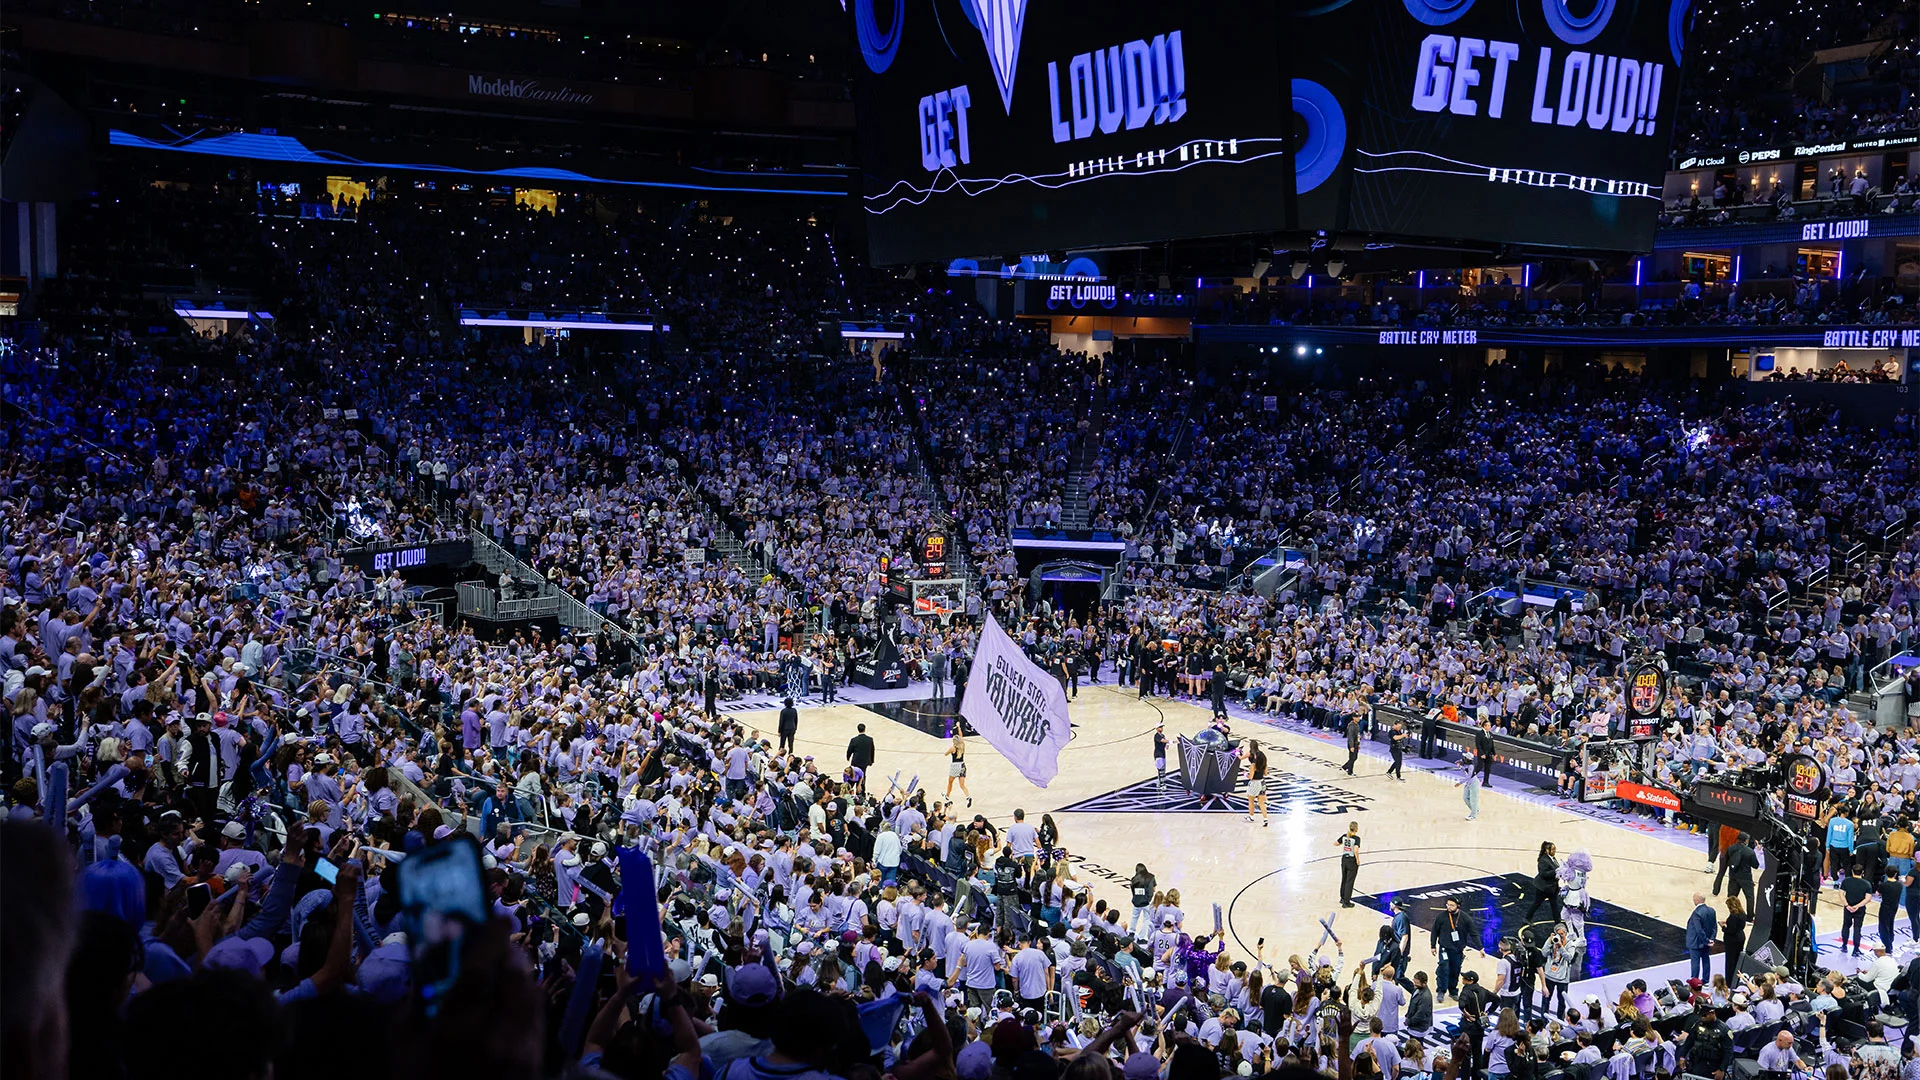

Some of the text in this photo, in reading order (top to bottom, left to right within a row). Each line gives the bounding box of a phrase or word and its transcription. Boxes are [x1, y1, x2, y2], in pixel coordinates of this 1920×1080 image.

[468, 74, 594, 104] Modelo Cantina
[1412, 34, 1664, 136] GET LOUD!!
[919, 30, 1187, 171] GET LOUD!!
[1794, 142, 1846, 156] RingCentral
[1853, 137, 1918, 149] UNITED AIRLINES
[1069, 139, 1238, 177] BATTLE CRY METER
[1697, 159, 1705, 167] AI
[1705, 156, 1725, 166] Cloud
[1751, 149, 1780, 161] PEPSI
[1489, 167, 1649, 197] BATTLE CRY METER
[1802, 220, 1869, 240] GET LOUD!!
[1050, 285, 1116, 300] GET LOUD!!
[1130, 291, 1195, 307] verizon
[1379, 330, 1477, 345] BATTLE CRY METER
[1823, 330, 1869, 347] BATTLE
[1872, 330, 1898, 347] CRY
[926, 544, 942, 558] 24
[374, 548, 426, 570] GET LOUD!!
[1636, 674, 1657, 687] 10:00
[1633, 687, 1655, 708] 24
[1639, 717, 1660, 725] TISSOT
[1436, 738, 1463, 752] WHERE
[1509, 758, 1533, 771] CAME
[1536, 765, 1561, 779] FROM
[1796, 764, 1818, 778] 10:00
[1795, 774, 1813, 791] 24
[1795, 795, 1818, 805] TISSOT
[1079, 863, 1131, 889] CENT
[1408, 885, 1482, 900] WNBA
[1159, 939, 1170, 950] 26
